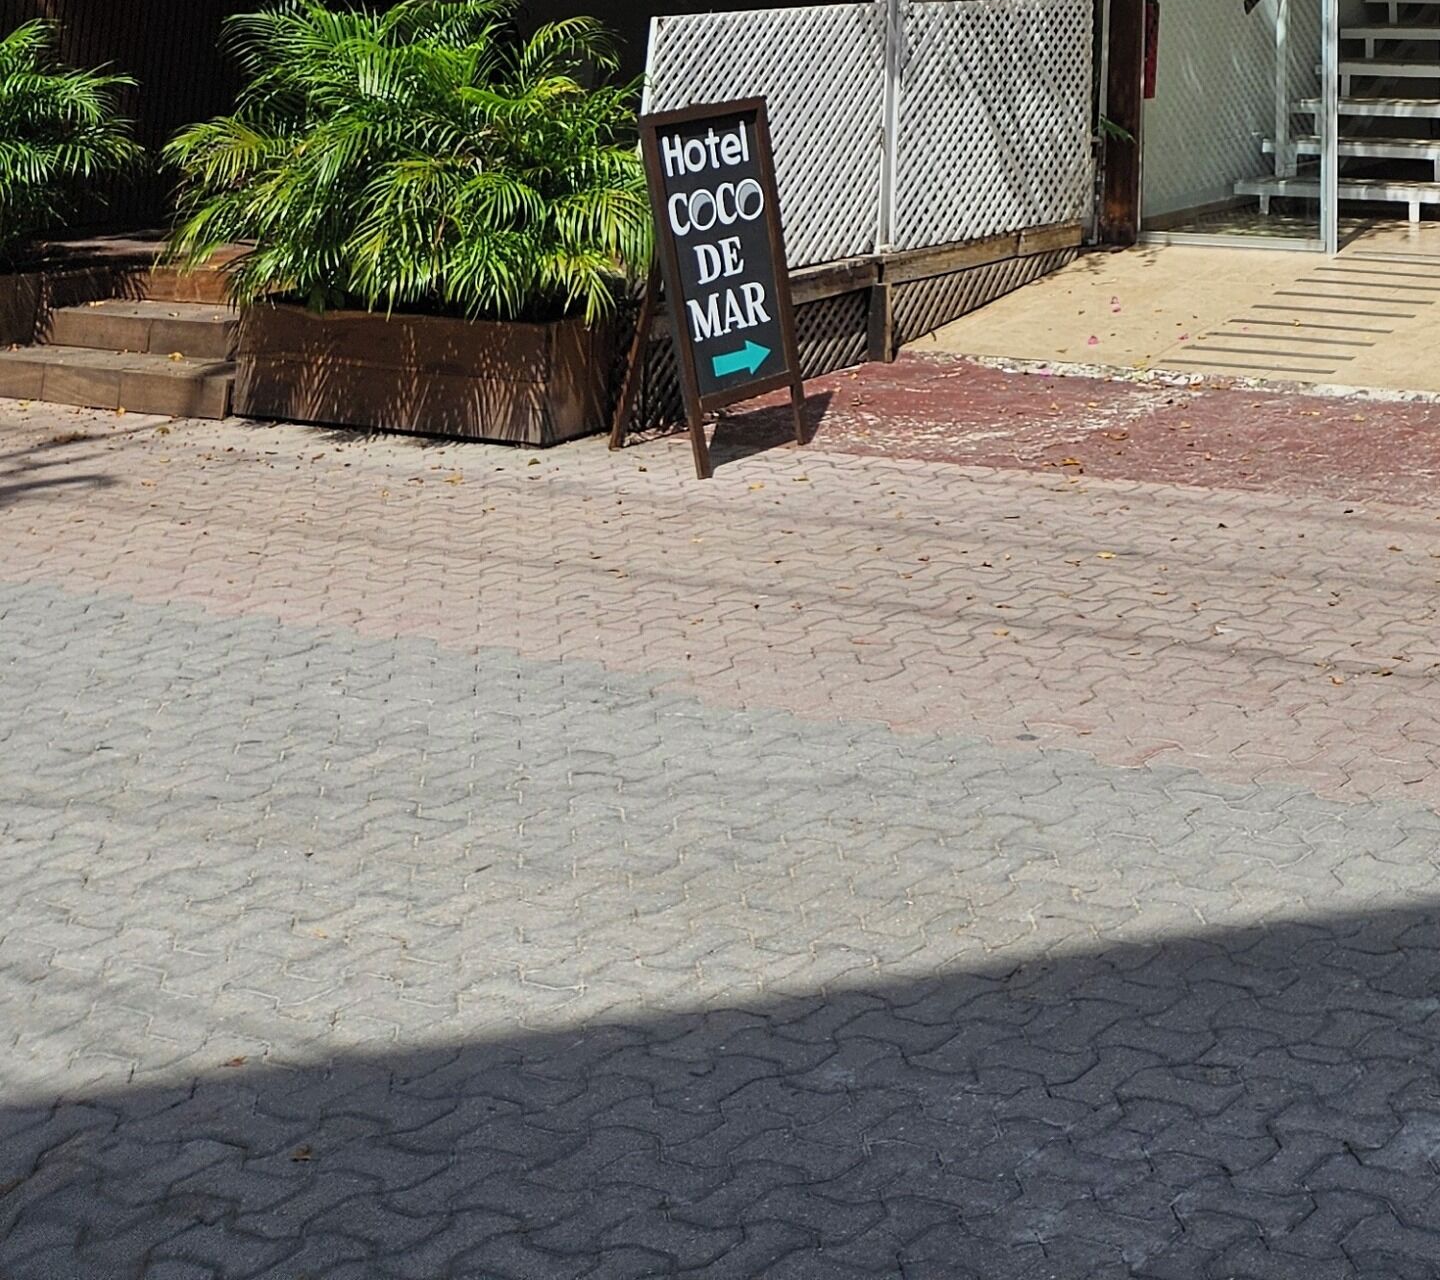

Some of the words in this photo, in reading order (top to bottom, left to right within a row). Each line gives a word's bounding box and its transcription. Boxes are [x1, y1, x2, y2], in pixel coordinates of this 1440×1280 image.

[662, 120, 749, 177] Hotel
[668, 178, 764, 236] COCO
[693, 236, 745, 285] DE
[686, 282, 771, 342] MAR
